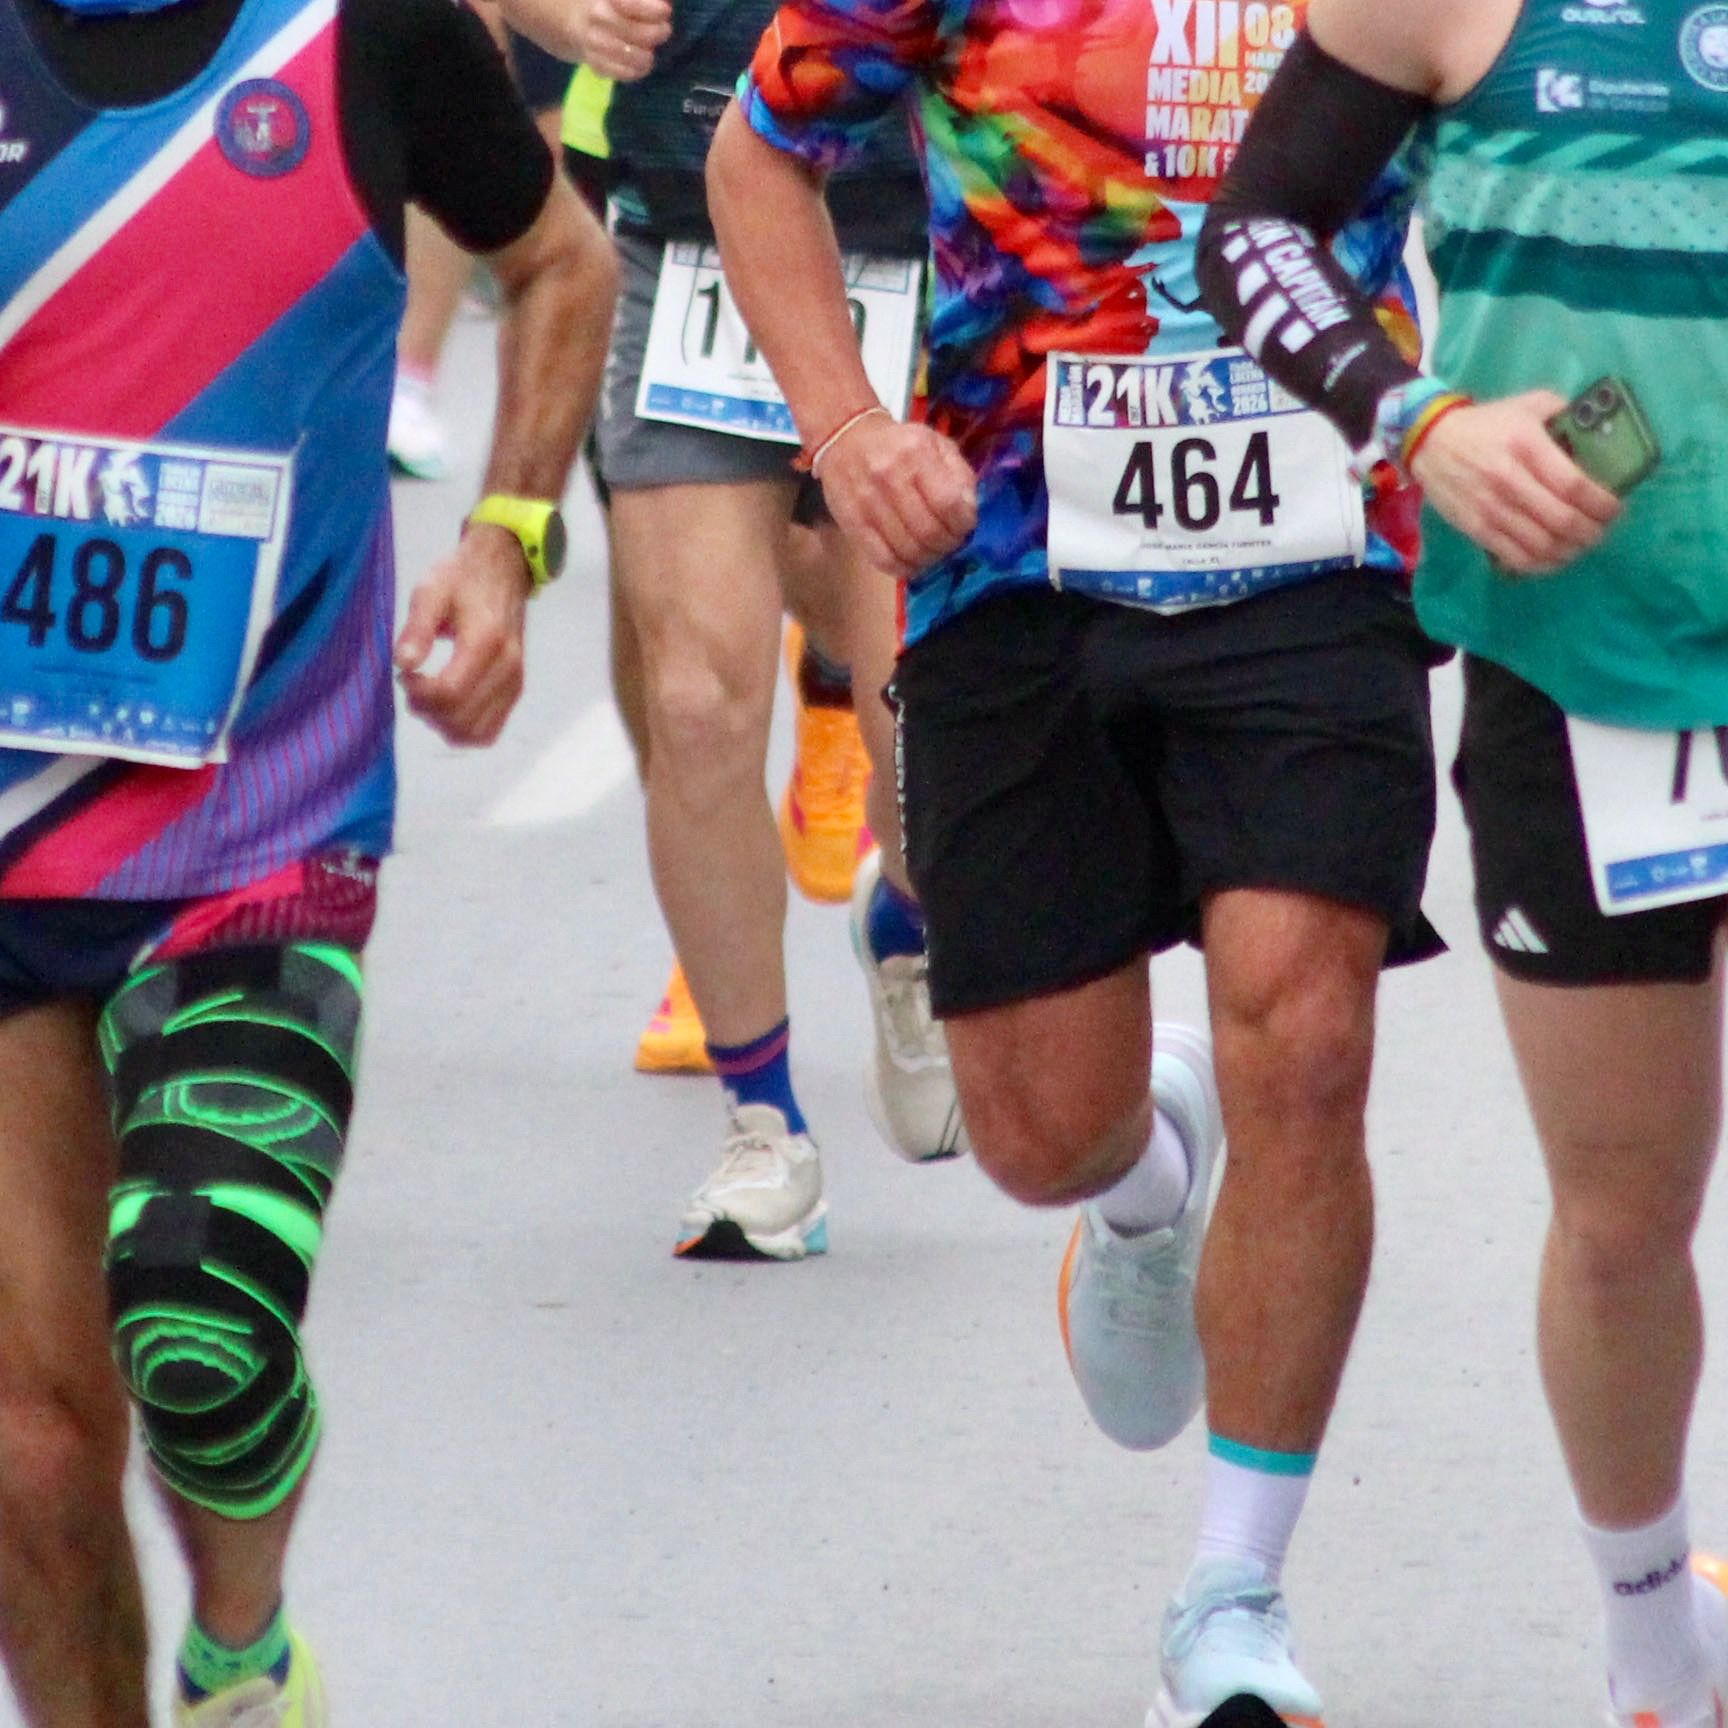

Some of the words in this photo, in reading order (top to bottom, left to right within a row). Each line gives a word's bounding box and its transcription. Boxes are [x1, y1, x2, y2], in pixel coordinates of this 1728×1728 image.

[1244, 2, 1297, 49] 08
[1147, 66, 1242, 106] MEDIA
[1165, 144, 1217, 178] 10K
[1085, 364, 1180, 427] 21K
[1111, 430, 1281, 533] 464
